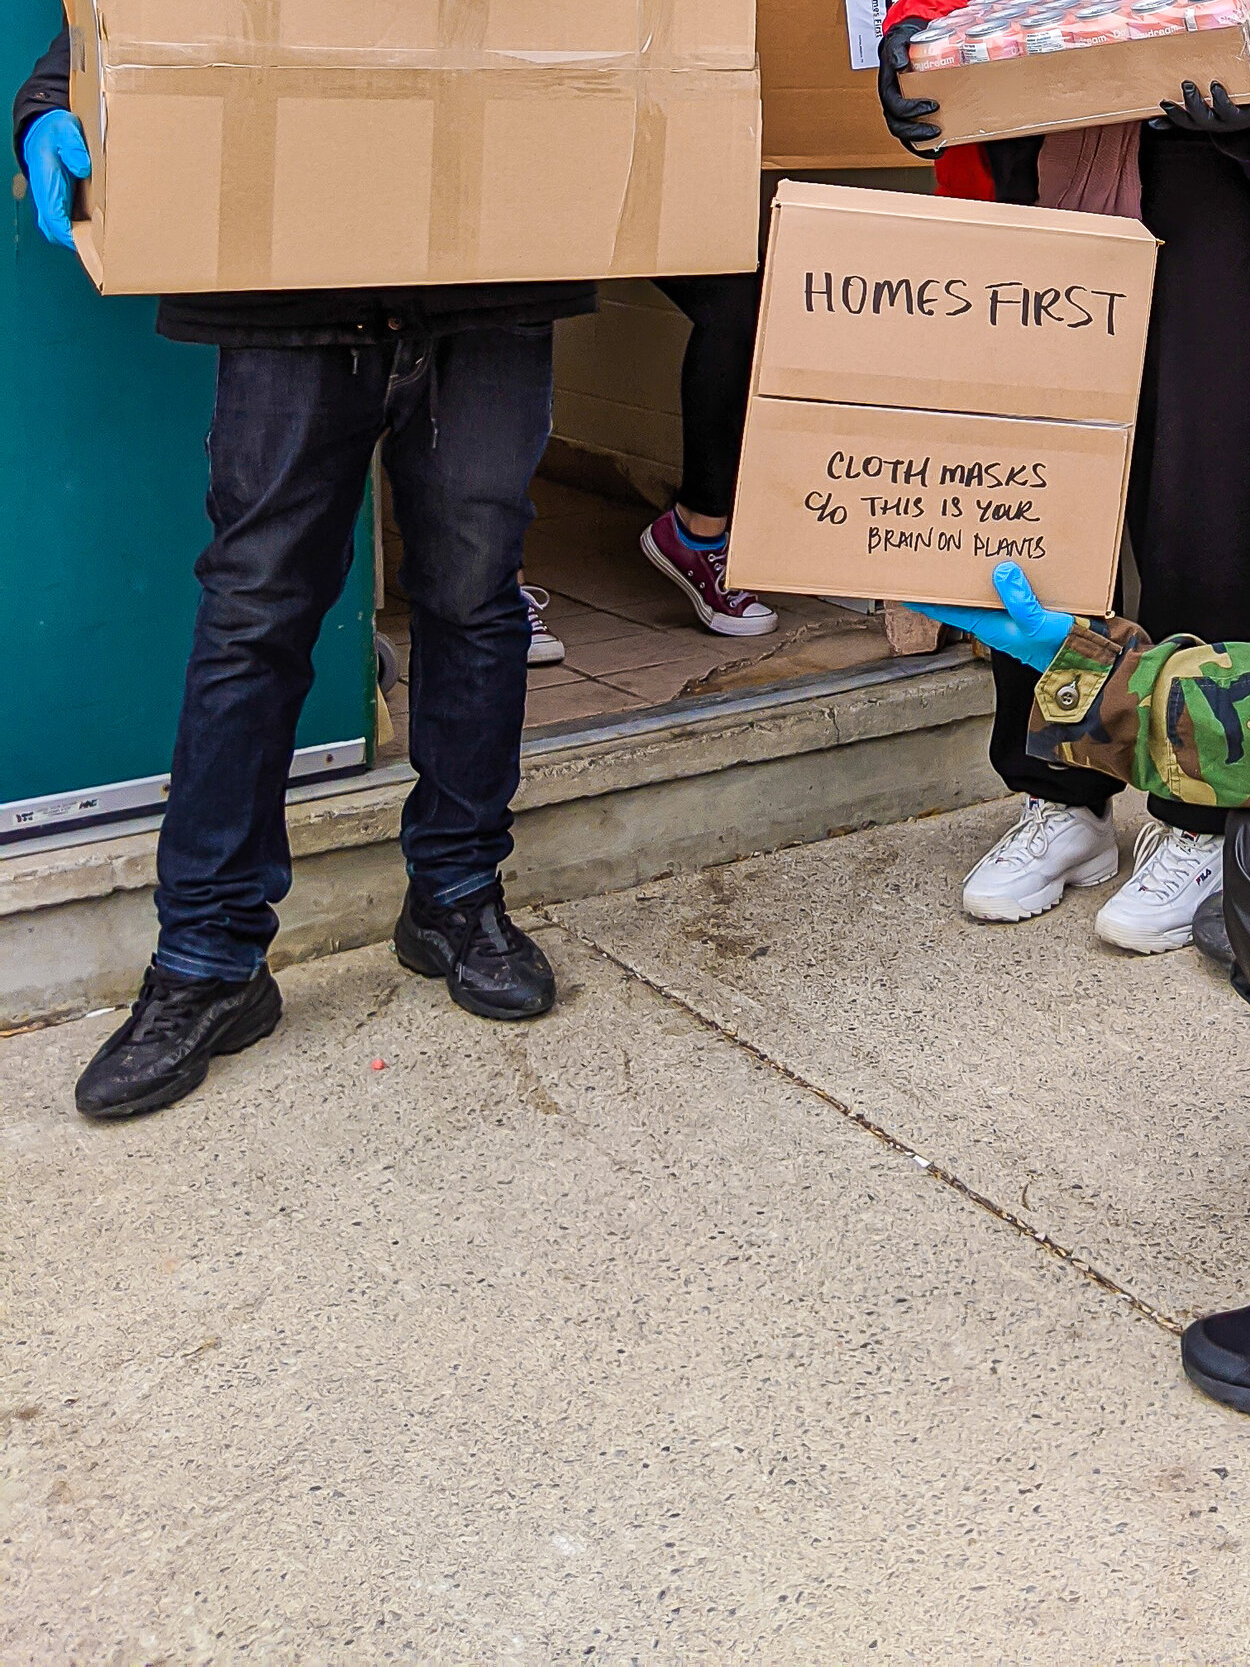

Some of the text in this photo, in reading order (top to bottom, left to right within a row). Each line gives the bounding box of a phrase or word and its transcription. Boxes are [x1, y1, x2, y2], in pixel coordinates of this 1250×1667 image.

[873, 19, 883, 38] First
[804, 272, 1127, 336] HOMES FIRST
[826, 450, 1048, 489] CLOTH MASKS
[860, 495, 925, 518] THIS
[941, 496, 963, 518] IS
[976, 498, 1041, 523] YOUR
[867, 526, 1047, 559] BRAIN ON PLANTS
